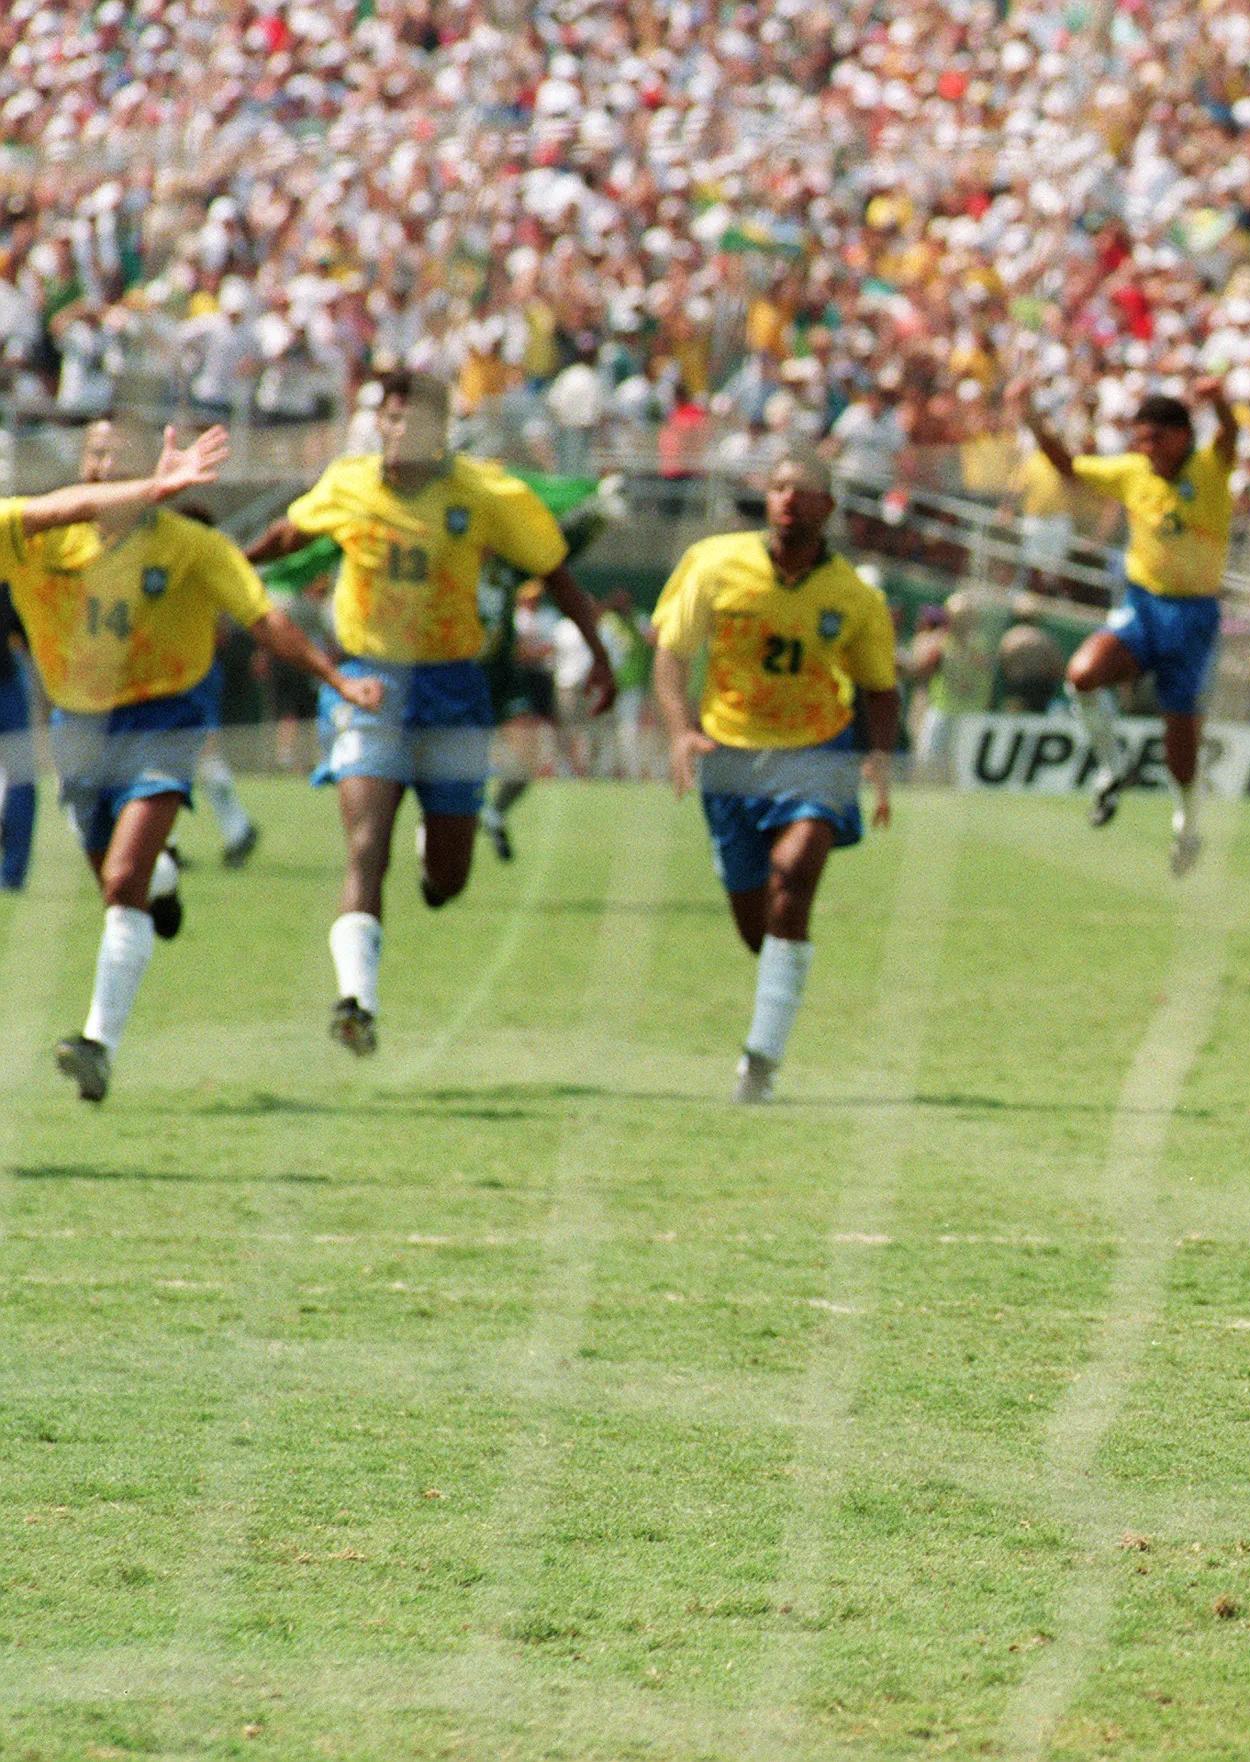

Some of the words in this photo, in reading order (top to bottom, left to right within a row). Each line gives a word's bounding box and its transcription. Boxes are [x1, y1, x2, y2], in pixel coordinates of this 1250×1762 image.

[389, 542, 428, 583] 13
[86, 596, 131, 642] 14
[762, 633, 803, 676] 21
